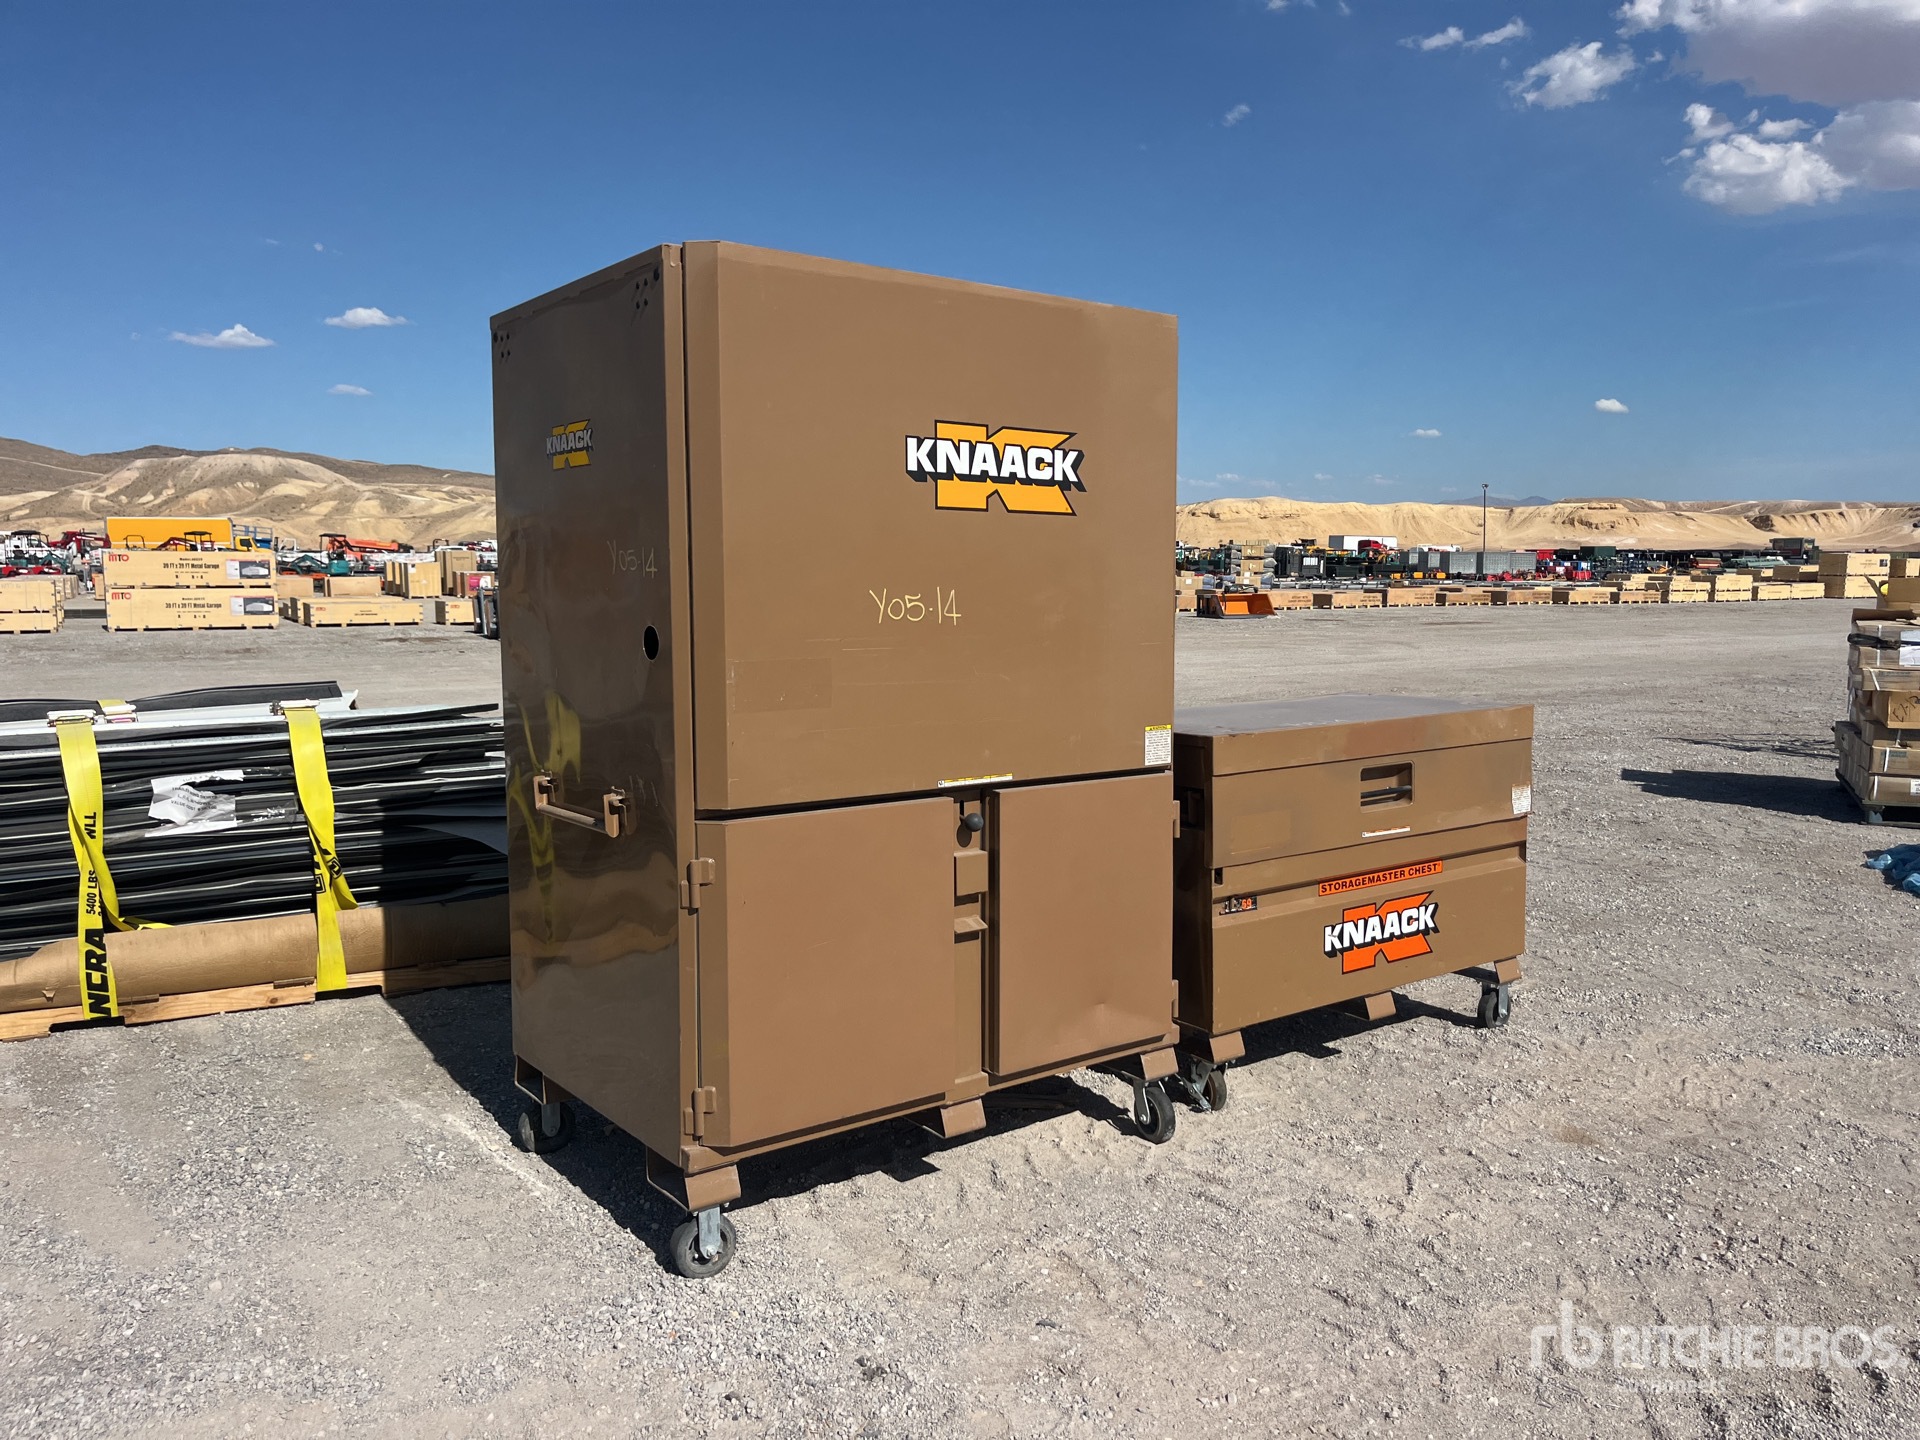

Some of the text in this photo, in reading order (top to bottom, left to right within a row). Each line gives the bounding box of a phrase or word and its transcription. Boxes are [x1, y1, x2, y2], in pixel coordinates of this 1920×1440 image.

[546, 429, 593, 456] KNAACK
[906, 436, 1084, 487] KNAACK
[86, 870, 98, 915] 5400 LBS
[1321, 863, 1439, 893] STORAGEMASTER CHEST
[1323, 903, 1438, 955] KNAACK
[85, 928, 112, 1019] NCRA
